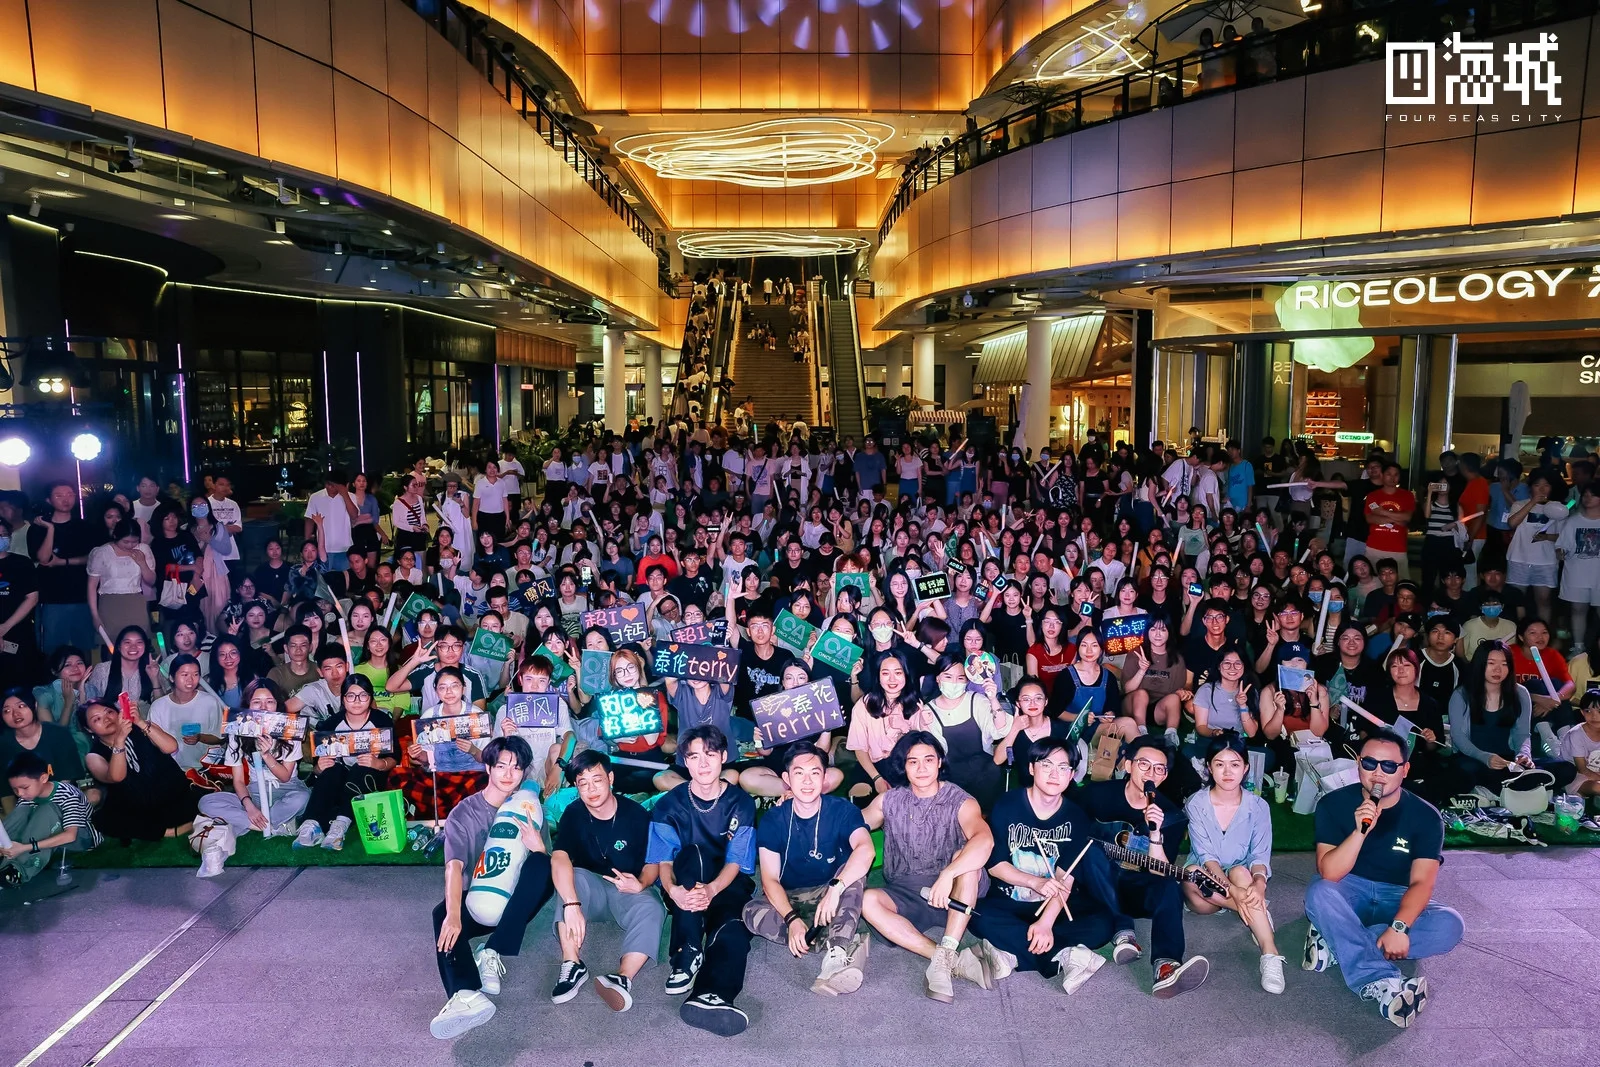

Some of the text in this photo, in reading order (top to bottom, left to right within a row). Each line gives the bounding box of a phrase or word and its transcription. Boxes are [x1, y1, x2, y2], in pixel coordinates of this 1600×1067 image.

[1295, 267, 1575, 311] RICEOLOGY
[477, 647, 505, 658] ONCE AGAIN
[818, 651, 848, 669] ONCE AGAIN
[763, 710, 827, 742] Terry
